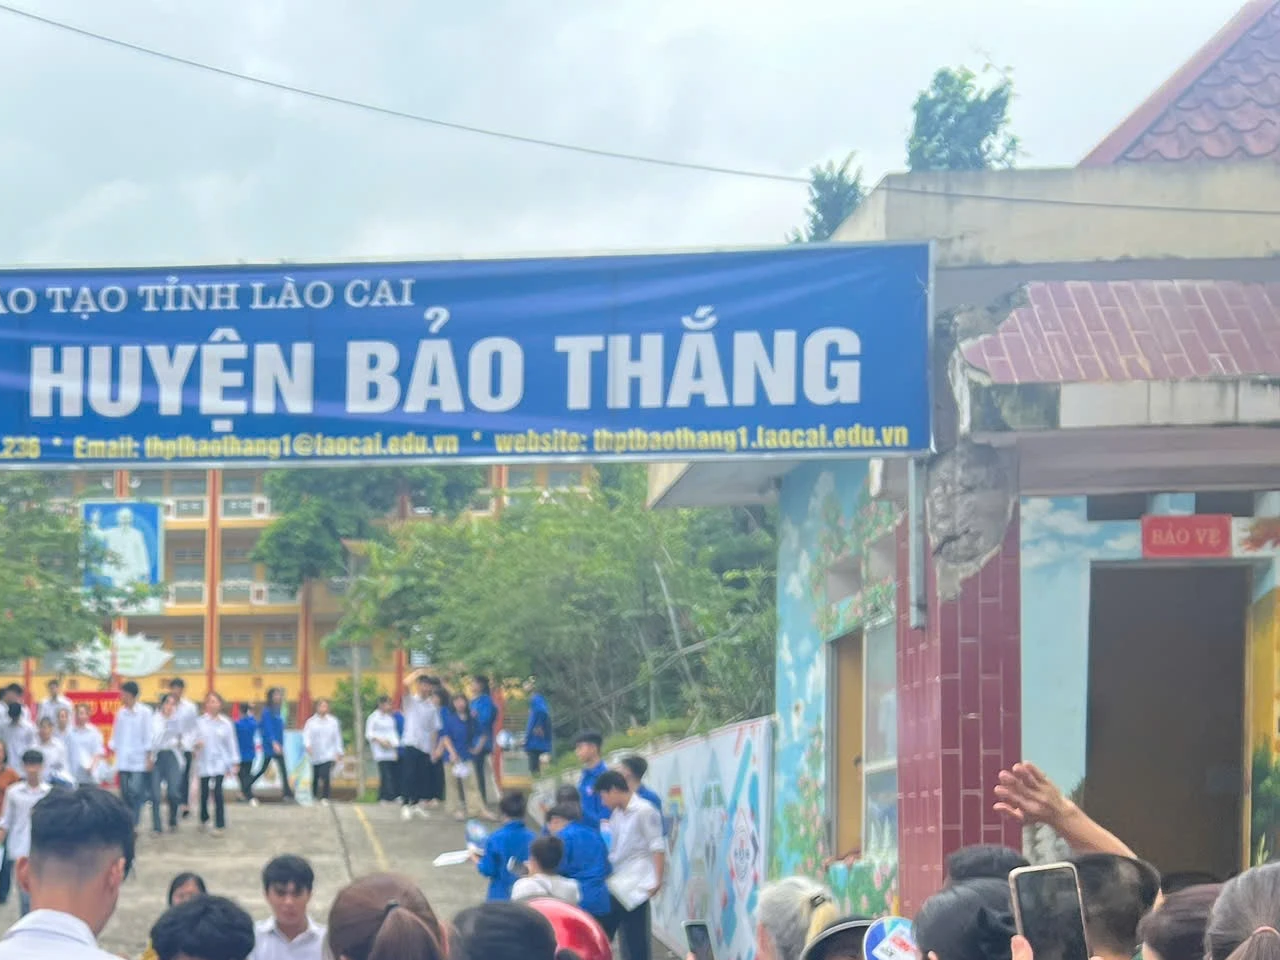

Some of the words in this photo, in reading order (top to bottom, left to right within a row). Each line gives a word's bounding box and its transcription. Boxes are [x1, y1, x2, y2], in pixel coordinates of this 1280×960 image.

[46, 286, 128, 320] TẠO
[137, 275, 240, 312] TỈNH
[249, 275, 333, 309] LÀO
[343, 279, 416, 307] CAI
[30, 327, 315, 432] HUYỆN
[346, 307, 525, 414] BẢO
[554, 305, 862, 410] THẮNG
[73, 436, 139, 459] Email:
[494, 427, 588, 453] website:
